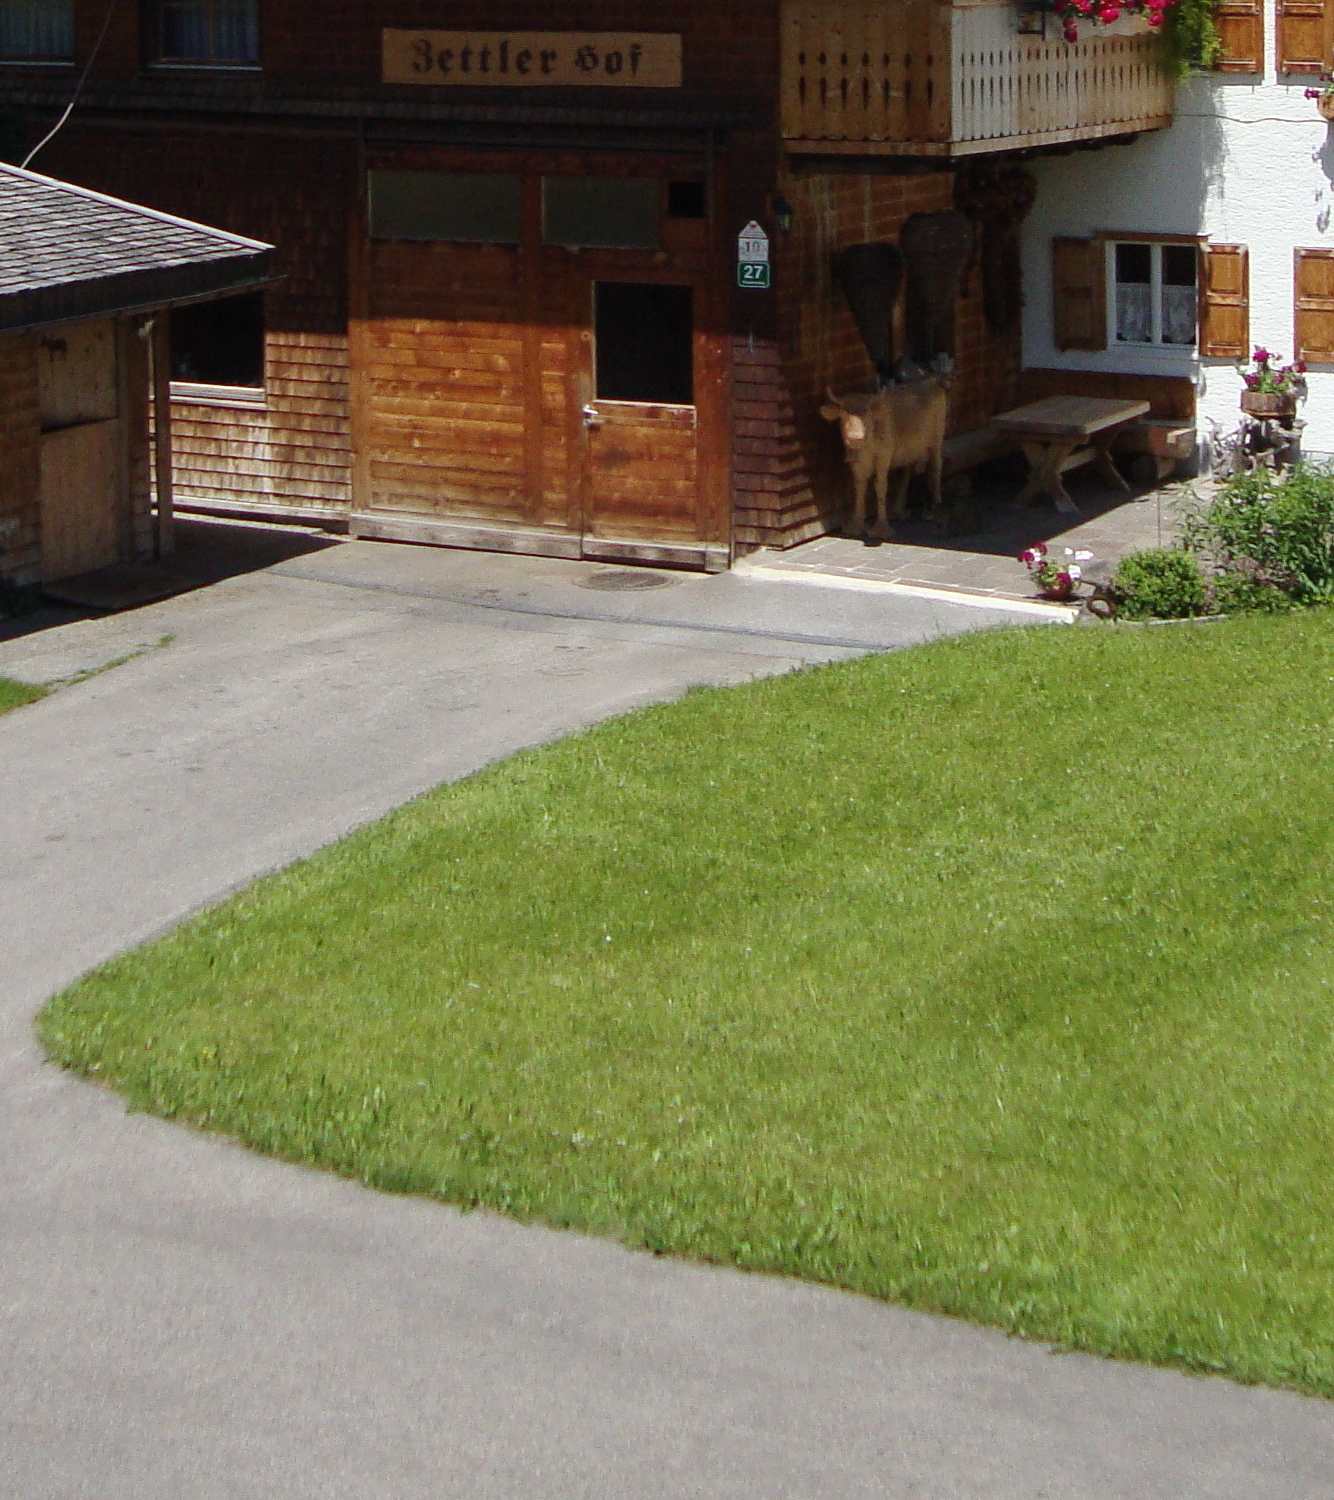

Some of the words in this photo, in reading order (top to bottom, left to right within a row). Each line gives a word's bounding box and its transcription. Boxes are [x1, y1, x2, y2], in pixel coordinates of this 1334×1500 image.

[411, 37, 558, 77] Zettler
[574, 43, 643, 77] Hof
[743, 264, 764, 280] 27
